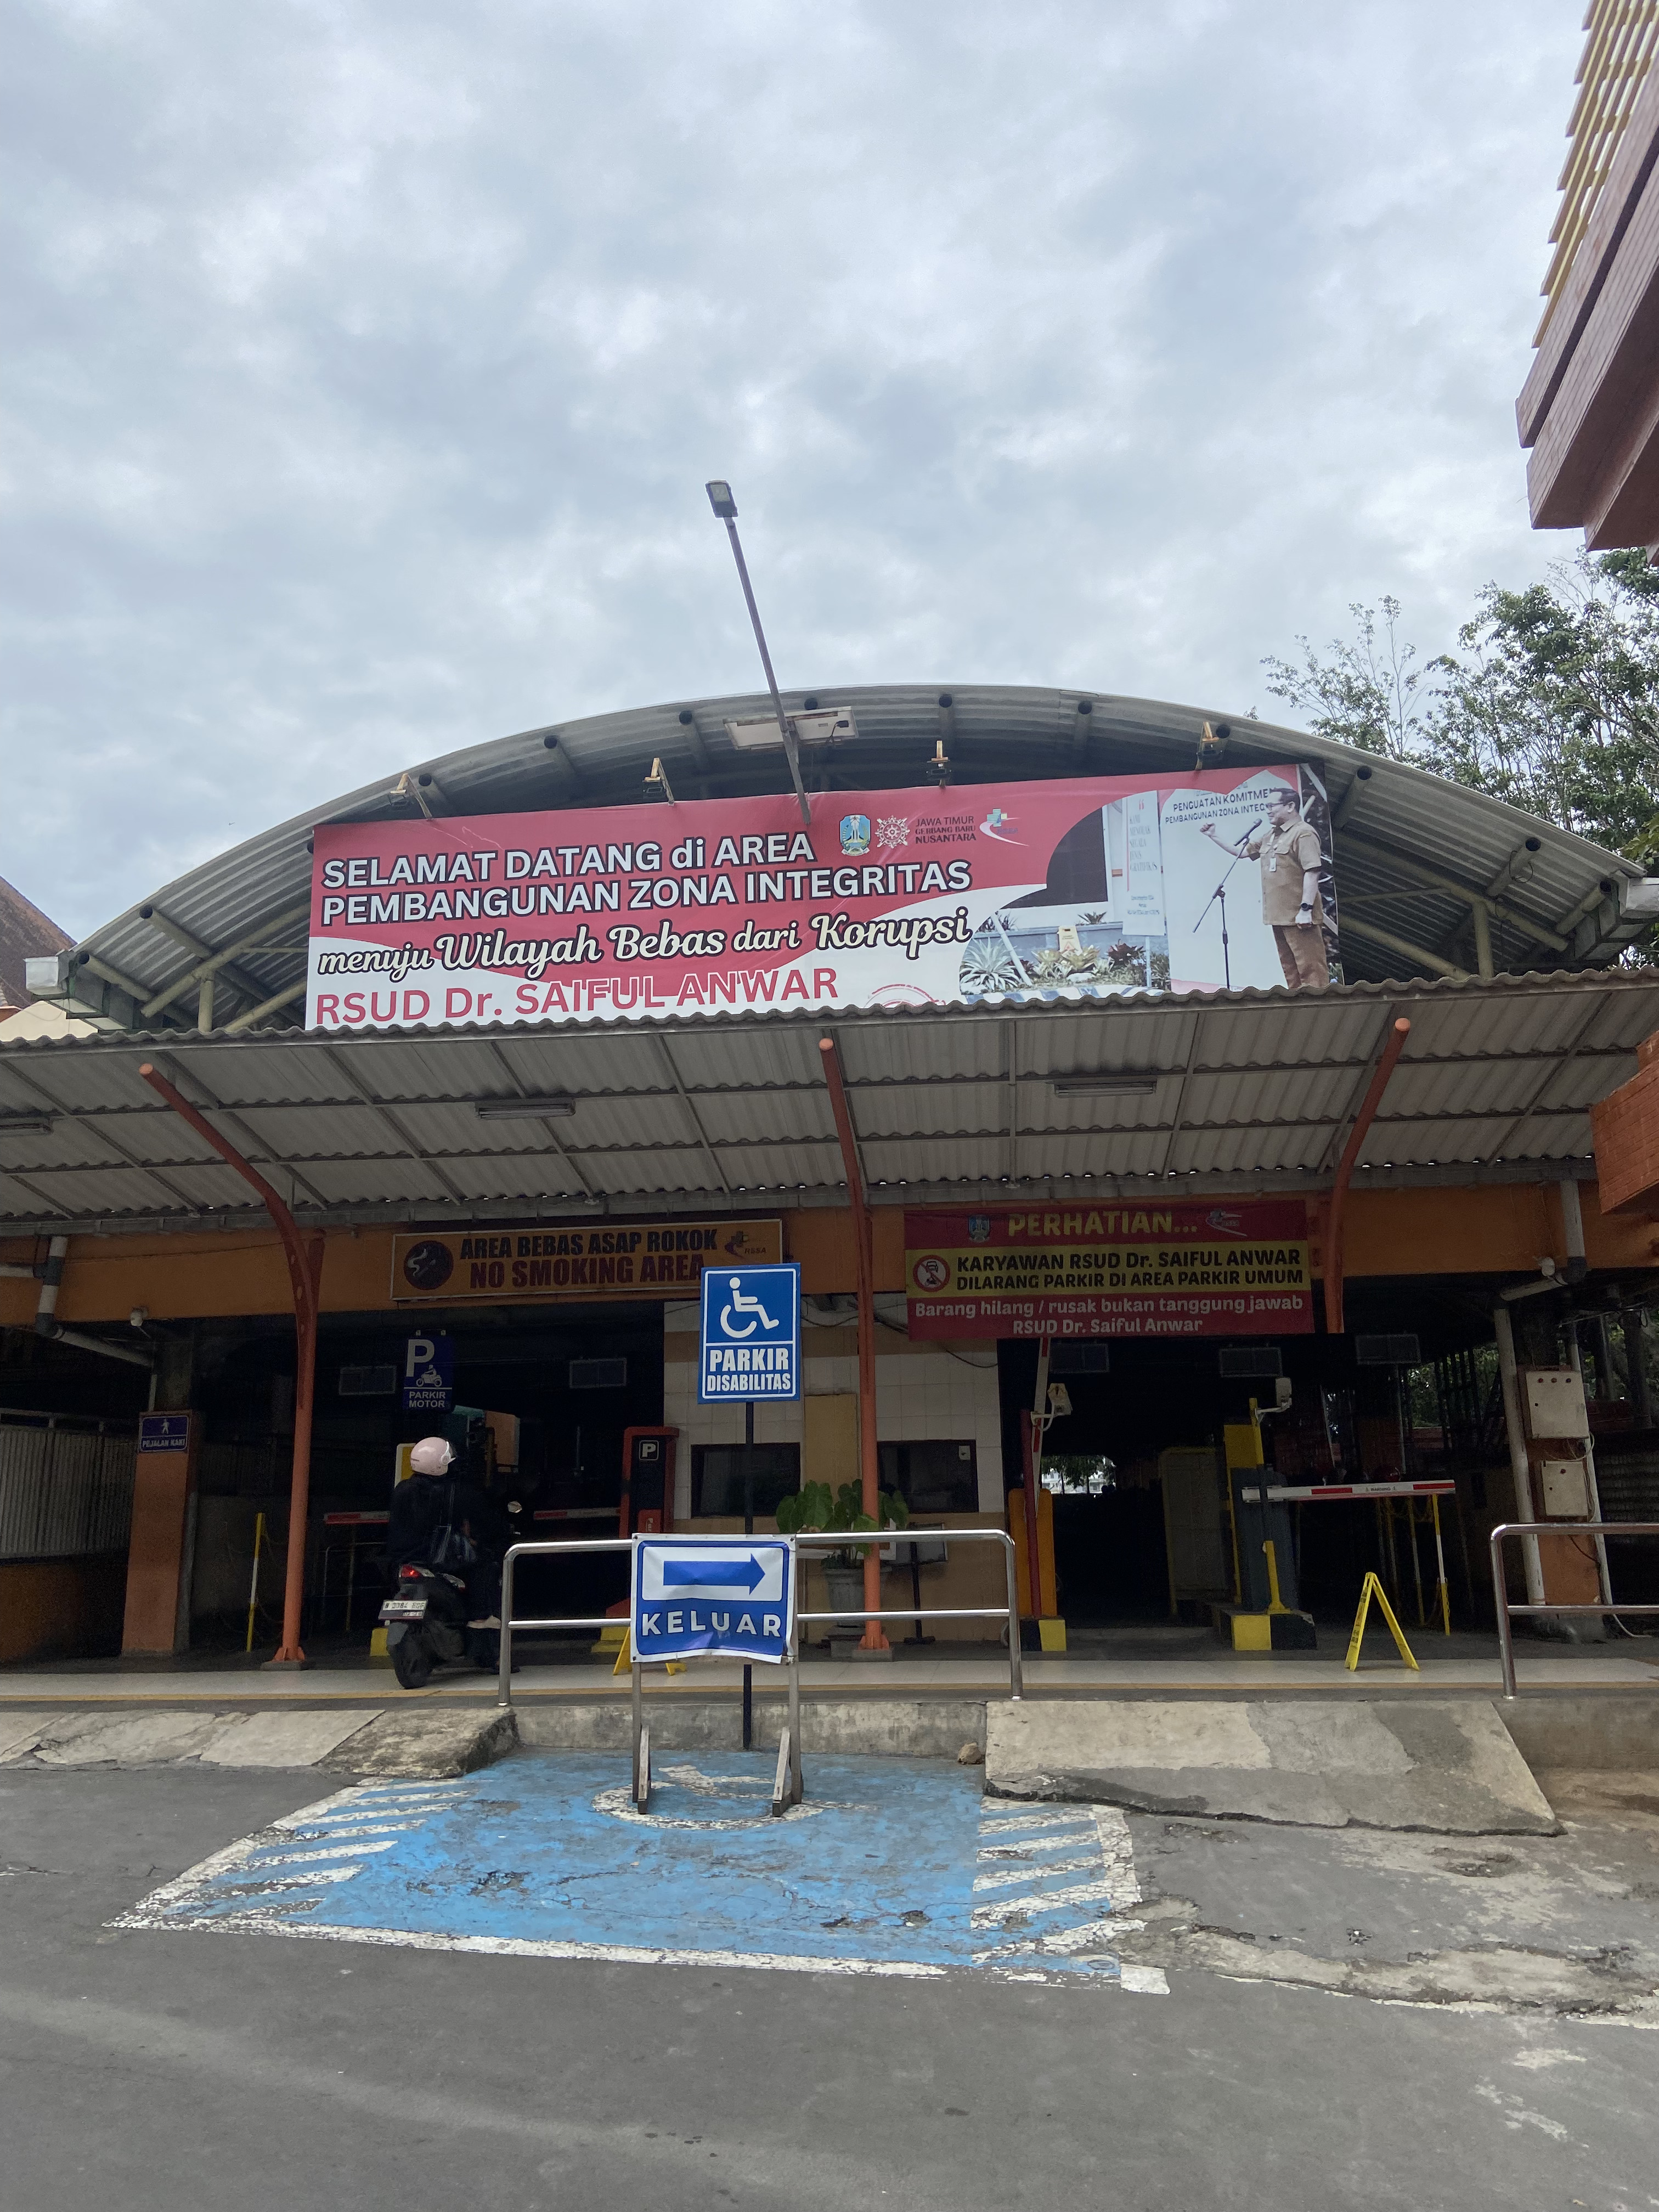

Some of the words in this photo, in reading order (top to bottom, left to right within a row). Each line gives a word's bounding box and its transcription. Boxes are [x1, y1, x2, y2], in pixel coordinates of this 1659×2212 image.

[1165, 810, 1217, 824] PEMBANGUNAN
[1218, 807, 1240, 817] ZONA
[1241, 803, 1267, 813] INTEG
[1173, 796, 1222, 812] PENGUATAN
[916, 818, 942, 827] JAWA
[944, 816, 974, 825] TIMUR
[916, 833, 977, 844] NUSANTARA
[321, 850, 496, 889] SELAMAT
[504, 841, 663, 881] DATANG
[669, 838, 706, 870] di
[712, 831, 817, 867] AREA
[321, 881, 621, 927] PEMBANGUNAN
[628, 872, 737, 911] ZONA
[745, 859, 972, 902] INTEGRITAS
[317, 941, 434, 983] menuju
[434, 924, 603, 980] Wilayah
[608, 918, 725, 962] Bebas
[731, 918, 801, 952] dari
[809, 905, 973, 959] Korupsi
[315, 989, 431, 1025] RSUD
[444, 988, 503, 1019] Dr.
[515, 975, 665, 1014] SAIFUL
[677, 967, 838, 1007] ANWAR
[1008, 1211, 1198, 1237] PERHATIAN...
[461, 1237, 512, 1260] AREA
[517, 1234, 584, 1257] BEBAS
[588, 1232, 642, 1255] ASAP
[647, 1229, 718, 1251] ROKOK
[470, 1261, 505, 1289] NO
[512, 1254, 633, 1287] SMOKING
[640, 1254, 704, 1282] AREA
[957, 1254, 1063, 1272] KARYAWAN
[1070, 1253, 1120, 1269] RSUD
[1126, 1252, 1152, 1268] Dr.
[1158, 1251, 1222, 1267] SAIFUL
[1227, 1249, 1300, 1266] ANWAR
[957, 1274, 1039, 1290] DILARANG
[1044, 1273, 1104, 1287] PARKIR
[1110, 1273, 1126, 1286] DI
[1131, 1272, 1173, 1286] AREA
[1178, 1270, 1240, 1285] PARKIR
[1245, 1269, 1302, 1284] UMUM
[916, 1302, 976, 1319] Barang
[981, 1300, 1034, 1317] hilang
[1048, 1299, 1097, 1313] rusak
[1101, 1297, 1155, 1312] bukan
[1159, 1296, 1245, 1314] tanggung
[1247, 1295, 1304, 1313] jawab
[1013, 1319, 1057, 1334] RSUD
[1063, 1319, 1087, 1333] Dr.
[1091, 1318, 1141, 1333] Saiful
[1146, 1317, 1203, 1332] Anwar
[406, 1339, 435, 1377] P
[710, 1348, 789, 1372] PARKIR
[707, 1373, 791, 1391] DISABILITAS
[641, 1443, 656, 1457] P
[642, 1610, 781, 1638] KELUAR
